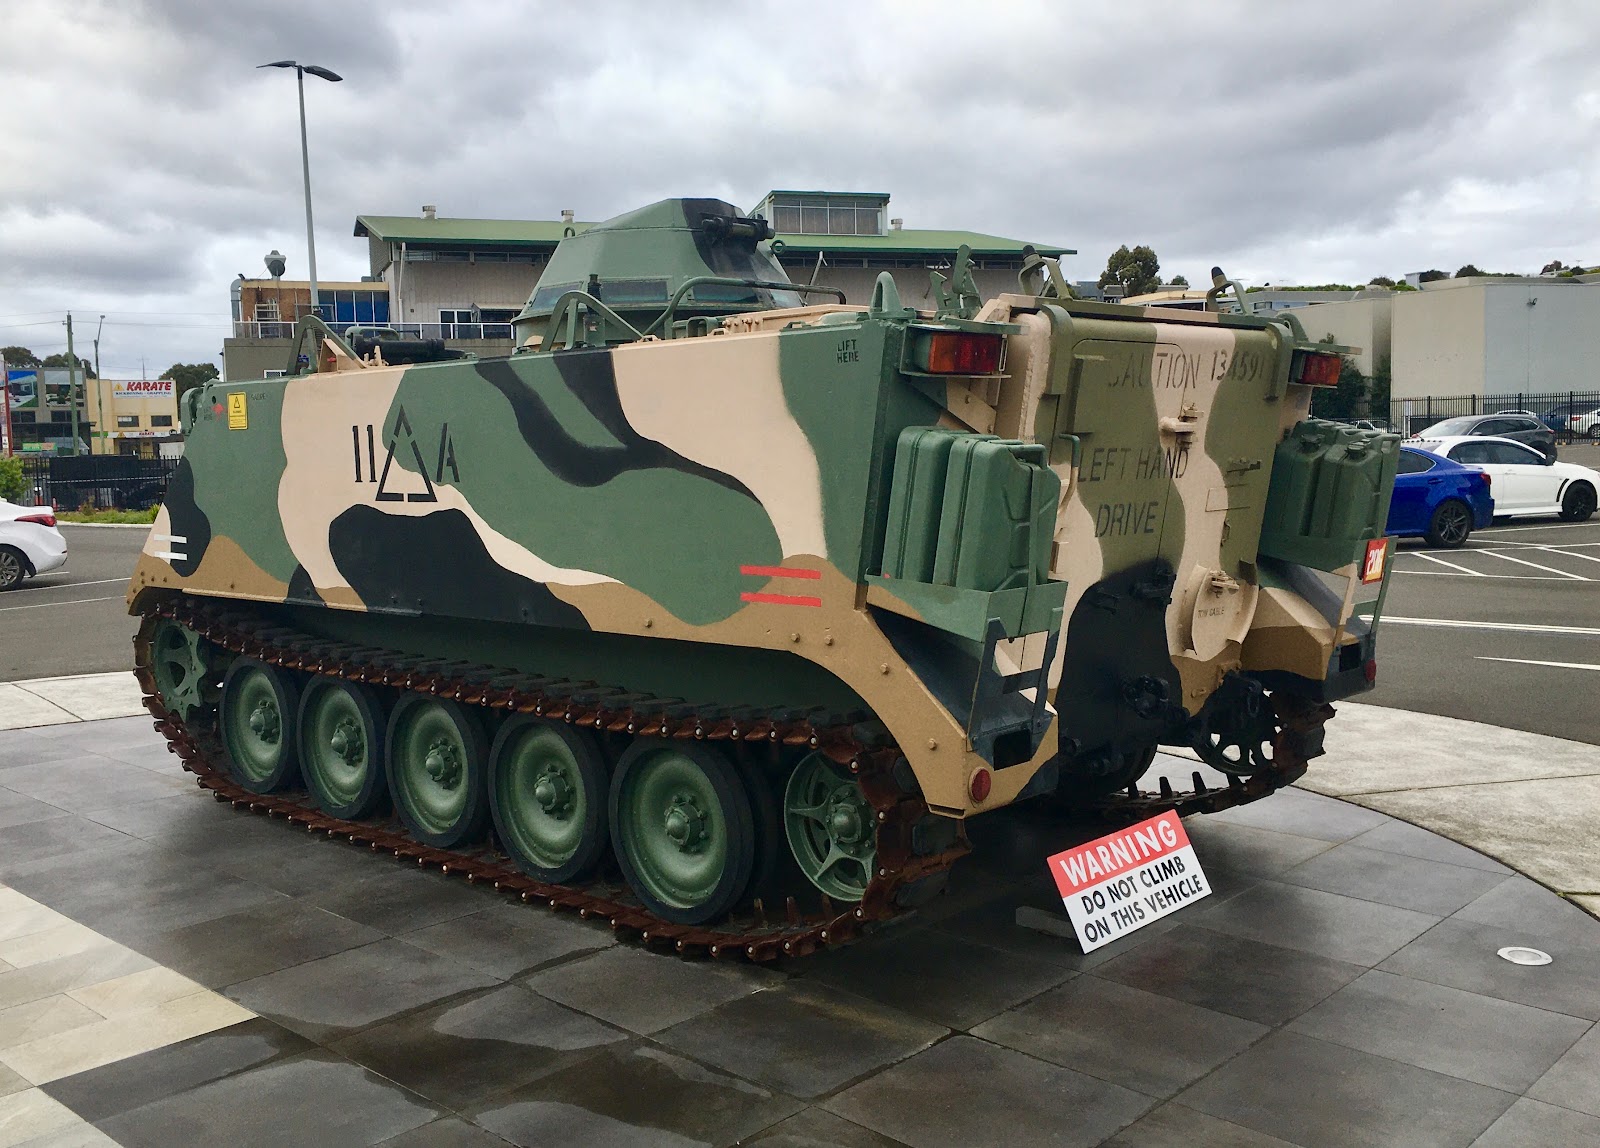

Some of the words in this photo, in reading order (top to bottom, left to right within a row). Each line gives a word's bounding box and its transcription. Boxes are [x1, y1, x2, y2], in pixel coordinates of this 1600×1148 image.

[836, 351, 860, 363] HERE
[837, 339, 857, 352] LIFT
[126, 381, 172, 391] KARATE
[1077, 447, 1131, 483] LEFT
[1135, 446, 1189, 480] HAND
[1094, 501, 1159, 538] DRIVE
[1059, 819, 1178, 888] WARNING
[1080, 890, 1106, 915] DO
[1106, 875, 1139, 904] NOT
[1139, 855, 1186, 888] CLIMB
[1084, 916, 1112, 943] ON
[1110, 901, 1146, 930] THIS
[1144, 874, 1203, 913] VEHICLE
